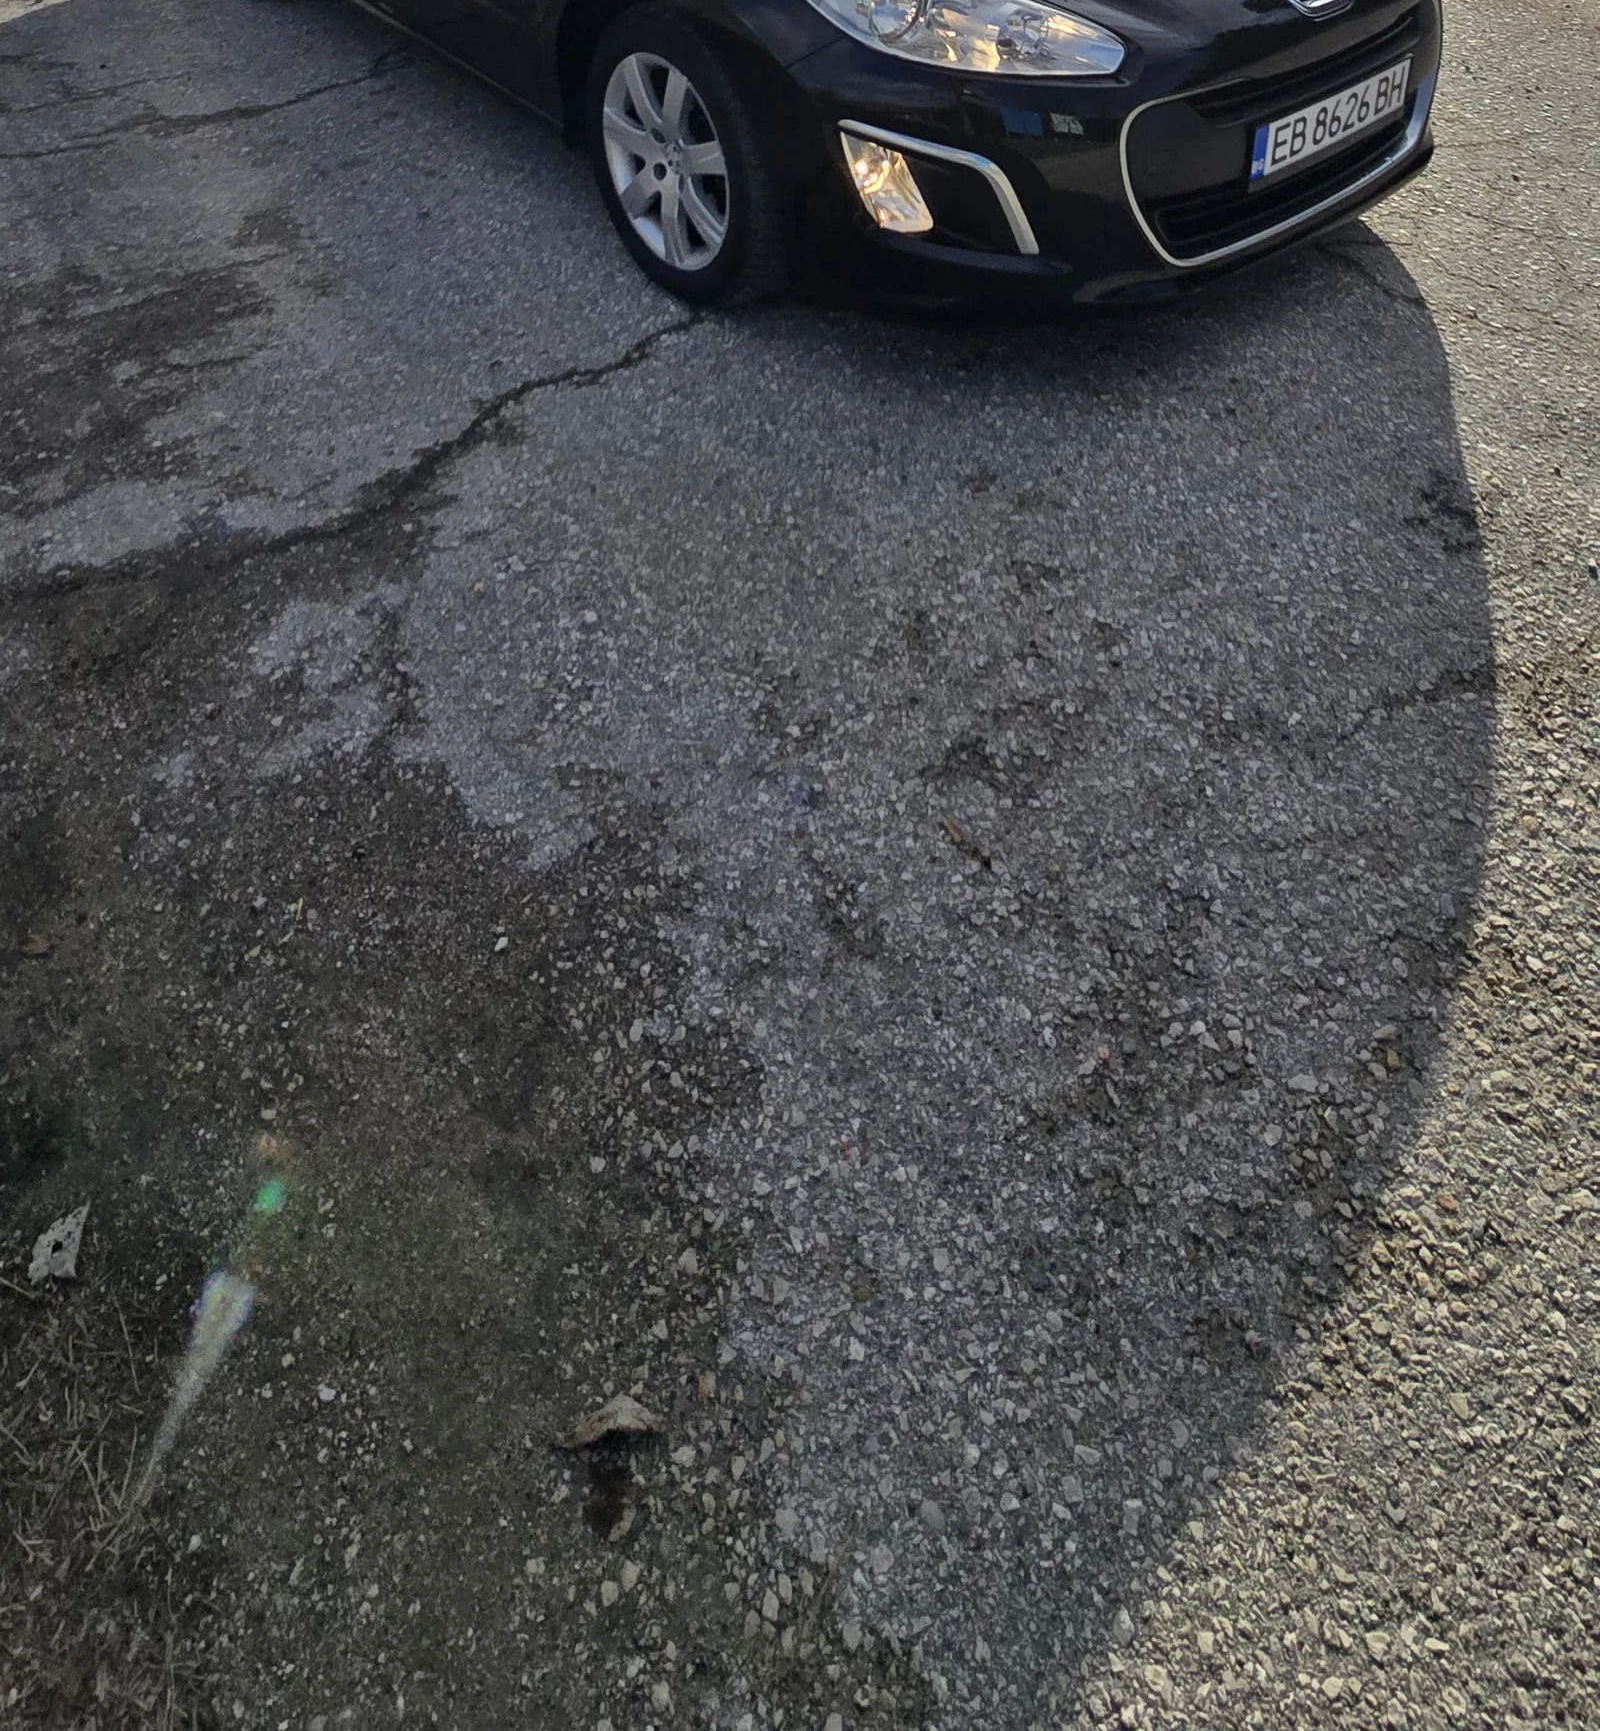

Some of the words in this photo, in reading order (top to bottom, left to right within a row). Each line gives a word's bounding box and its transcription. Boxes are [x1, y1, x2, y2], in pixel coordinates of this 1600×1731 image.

[1271, 116, 1307, 167] EB
[1312, 85, 1370, 146] 8626
[1374, 66, 1406, 115] BH
